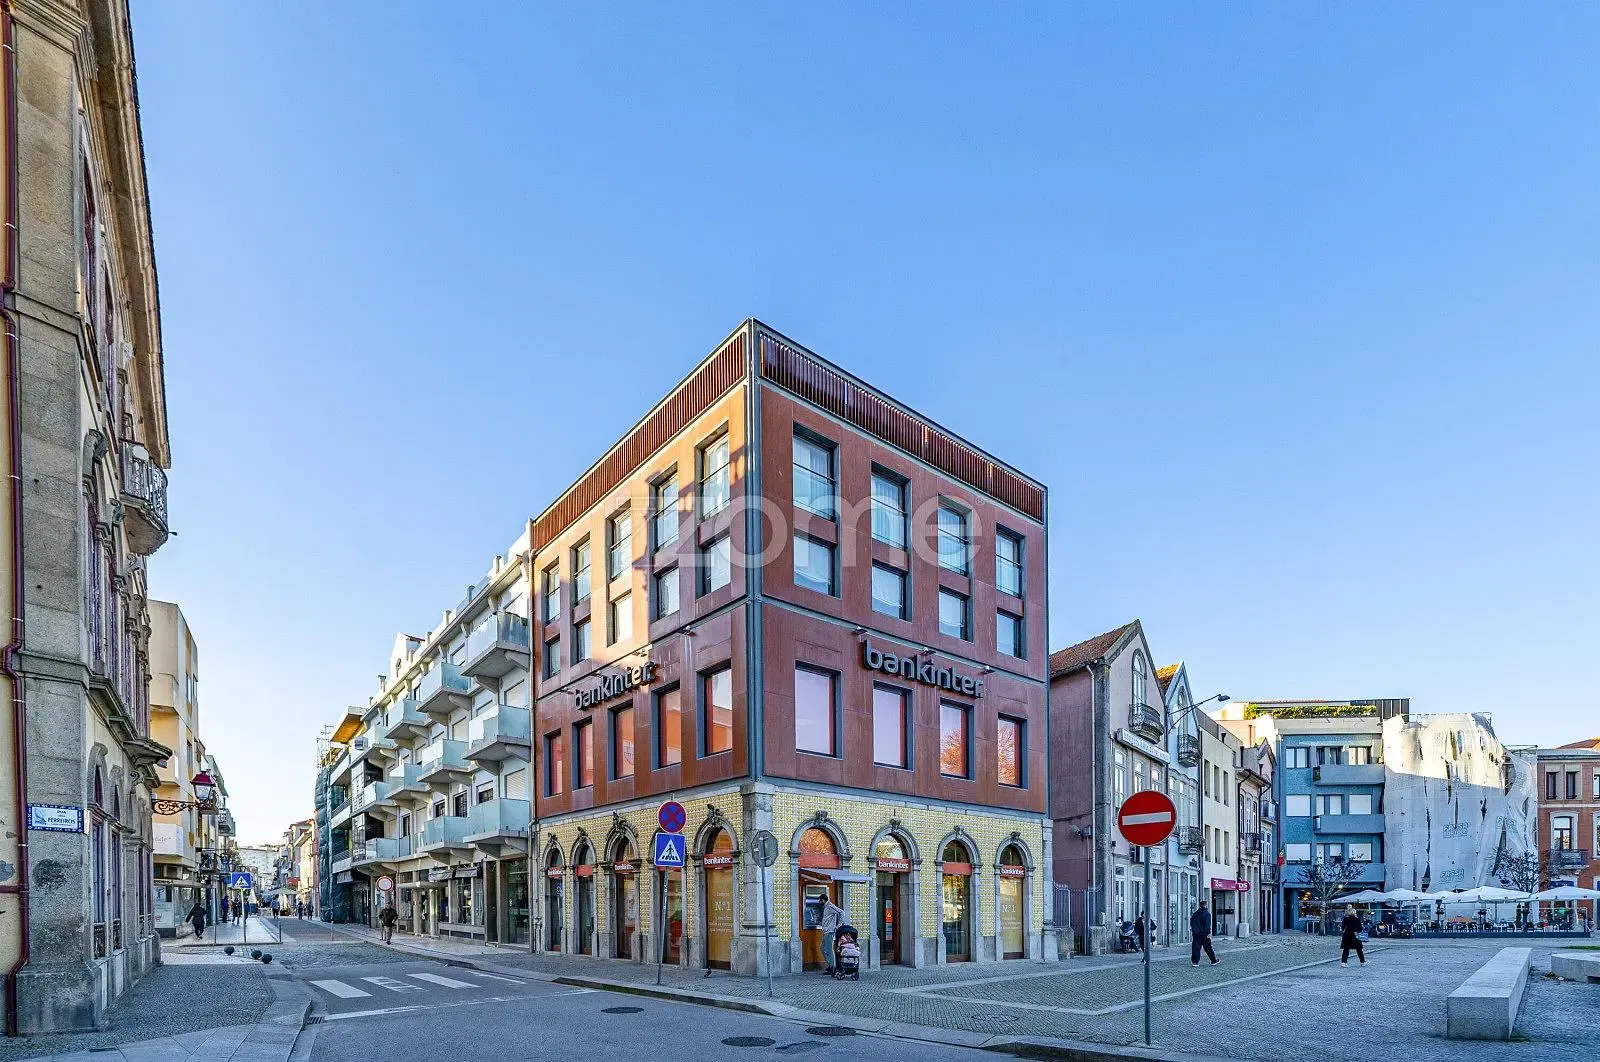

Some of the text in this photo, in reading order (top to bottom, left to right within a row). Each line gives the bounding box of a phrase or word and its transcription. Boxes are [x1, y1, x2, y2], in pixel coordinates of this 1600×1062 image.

[574, 661, 655, 710] bankinter
[863, 639, 984, 698] bankinter
[878, 860, 909, 869] bankinter
